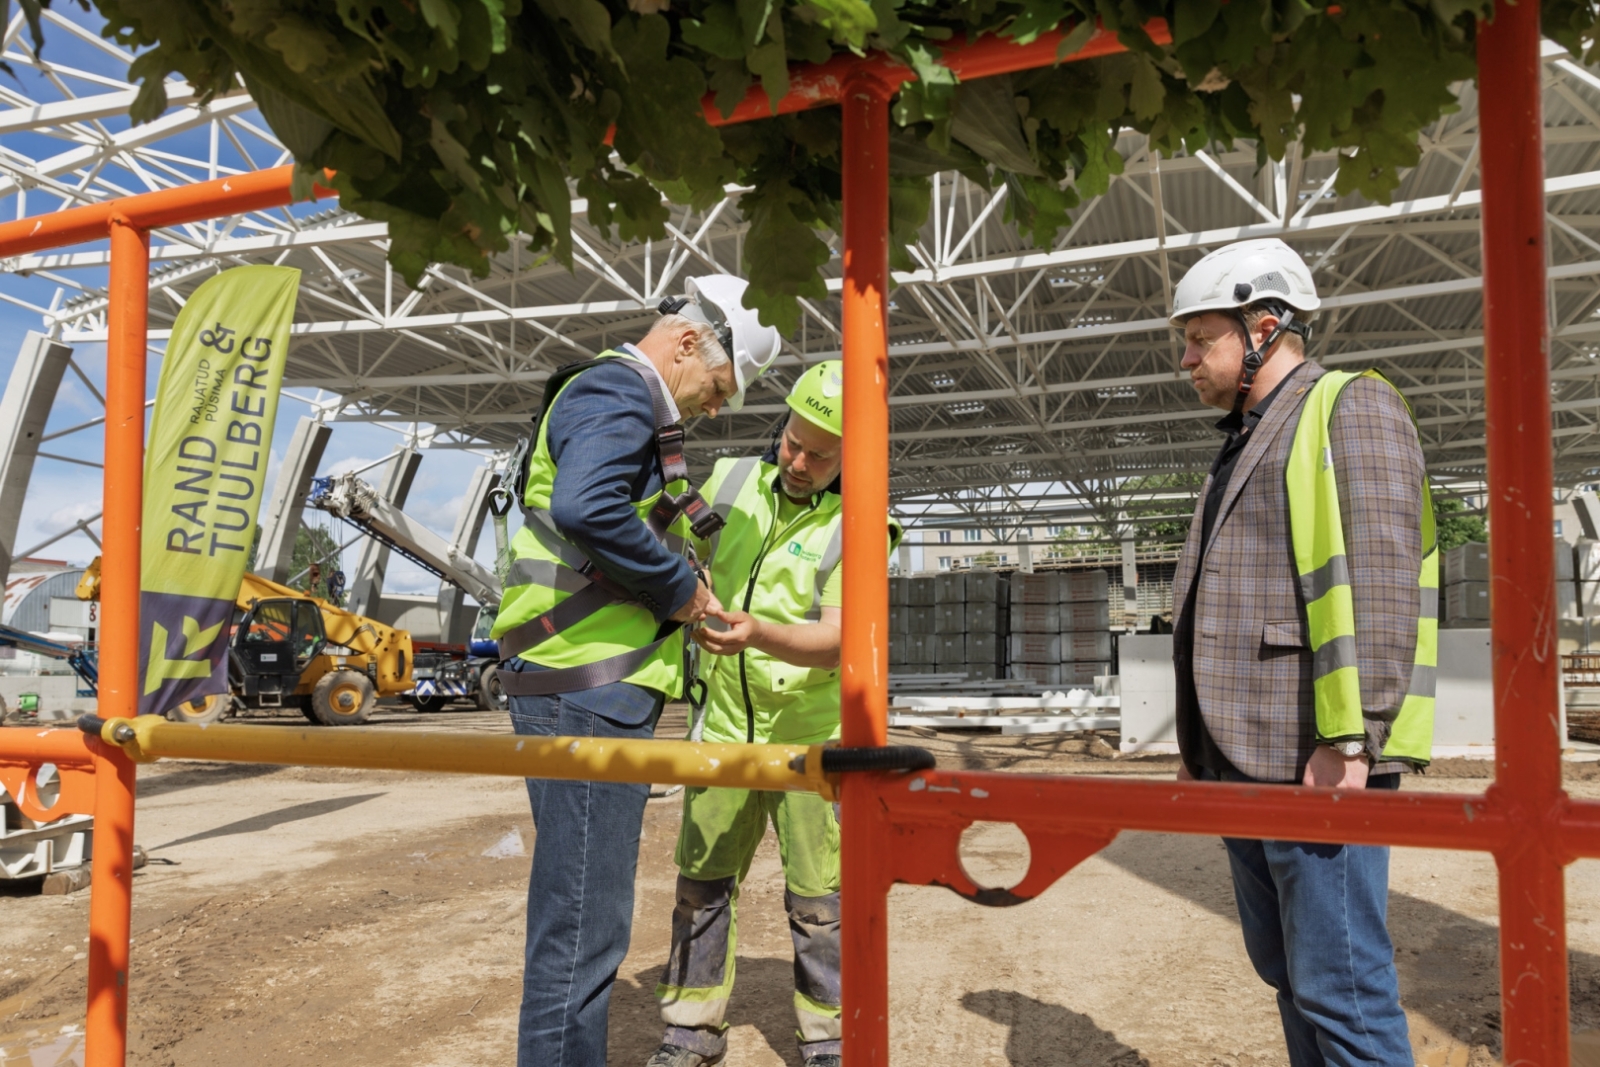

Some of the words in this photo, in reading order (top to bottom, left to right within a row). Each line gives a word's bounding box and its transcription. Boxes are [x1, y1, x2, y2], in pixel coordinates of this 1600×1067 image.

[190, 358, 211, 425] RAJATUD
[205, 368, 226, 423] PÜSIMA
[805, 395, 833, 418] KASK
[166, 436, 217, 555] RAND
[199, 322, 235, 354] &
[209, 335, 272, 557] TUULBERG
